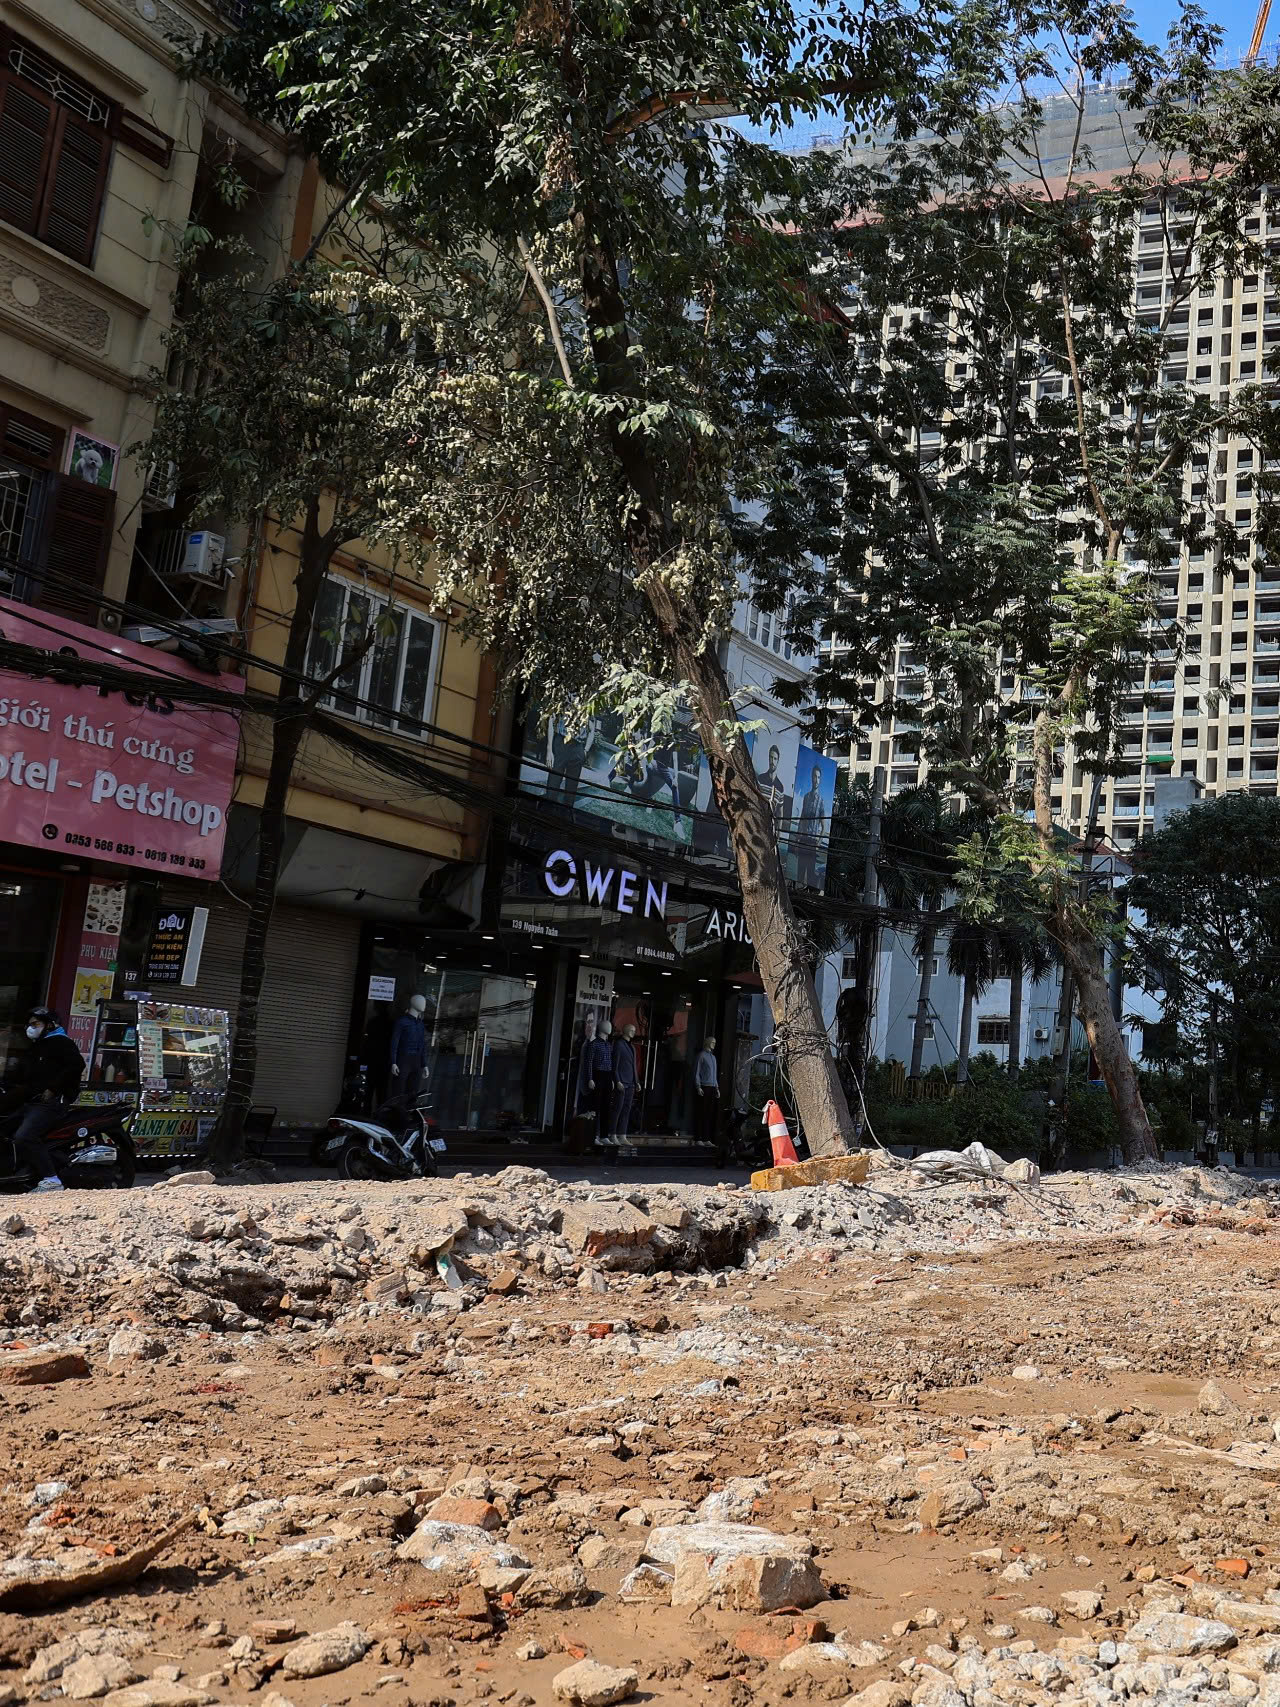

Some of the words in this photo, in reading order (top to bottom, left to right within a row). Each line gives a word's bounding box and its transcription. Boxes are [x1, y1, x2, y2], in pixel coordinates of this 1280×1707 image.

[63, 714, 115, 749] thú
[122, 735, 195, 774] cưng
[90, 769, 222, 837] Petshop
[544, 849, 668, 921] OWEN
[512, 919, 523, 929] 139
[80, 944, 96, 960] PHỤ
[124, 972, 137, 981] 137
[588, 973, 606, 990] 139
[132, 1114, 165, 1136] BÁNH
